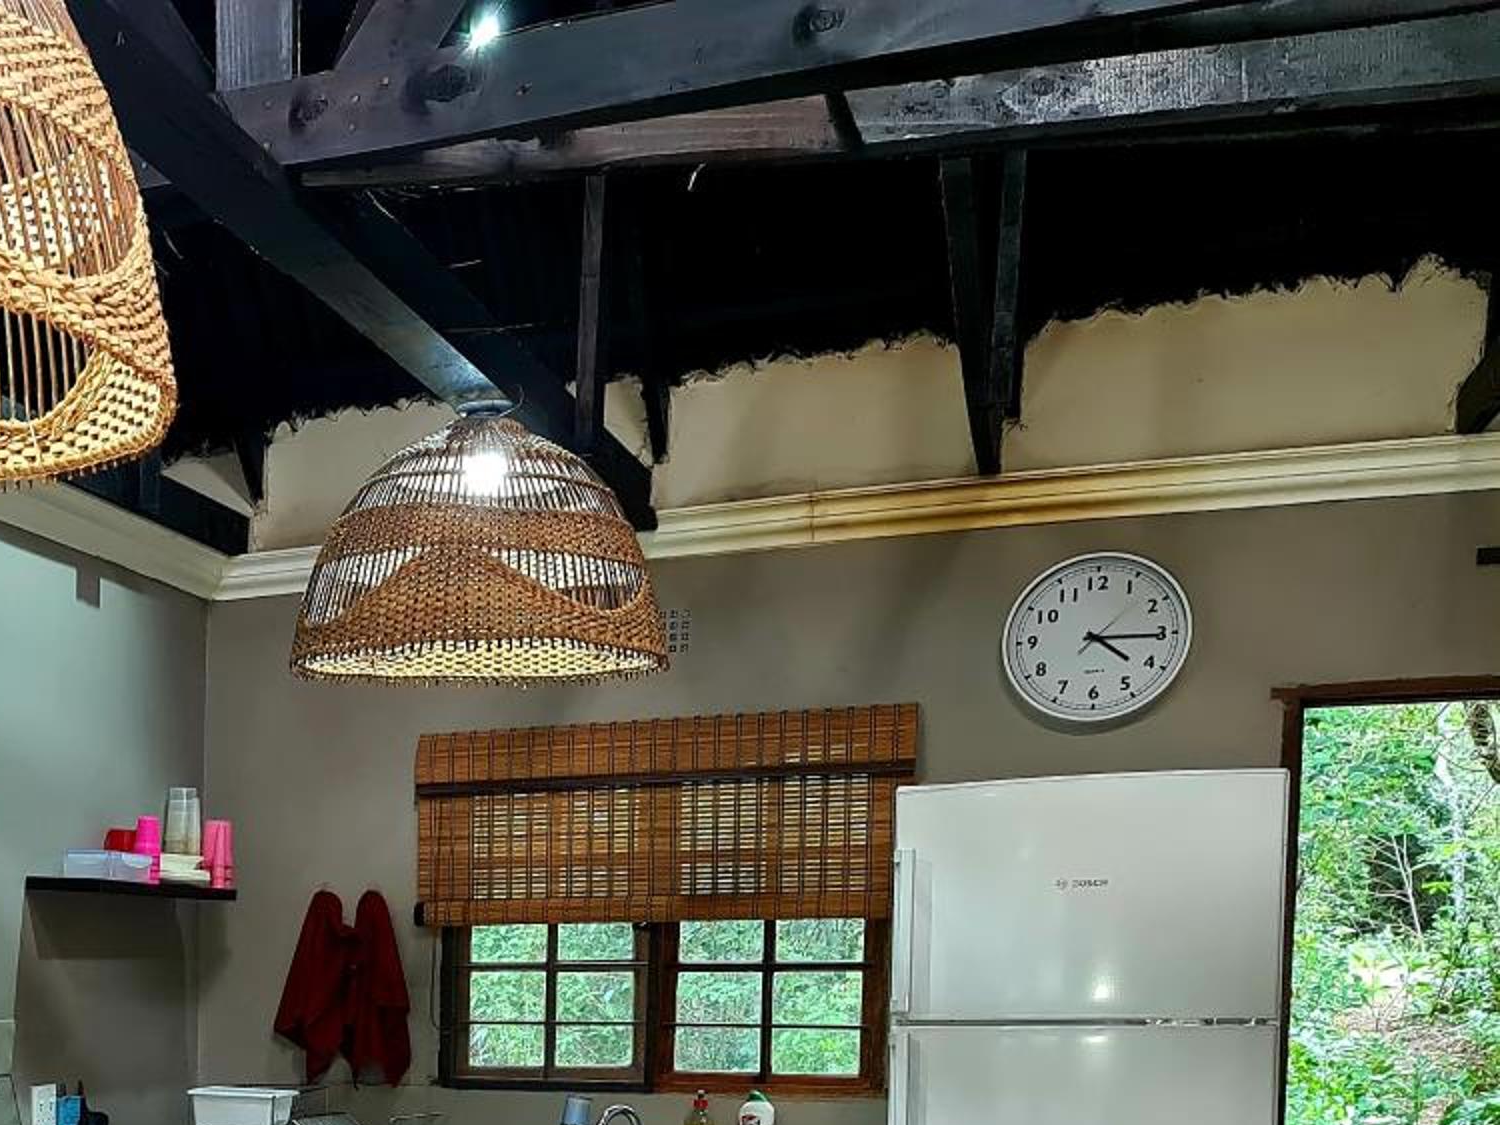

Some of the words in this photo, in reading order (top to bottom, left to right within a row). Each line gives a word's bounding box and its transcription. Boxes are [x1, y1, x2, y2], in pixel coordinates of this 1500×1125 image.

[1087, 575, 1109, 592] 12
[1127, 579, 1133, 595] 1
[1059, 587, 1078, 603] 11
[1147, 598, 1159, 614] 2
[1037, 609, 1059, 625] 10
[1156, 625, 1167, 641] 3
[1027, 635, 1038, 650] 9
[1035, 662, 1047, 677] 8
[1143, 655, 1155, 670] 4
[1057, 679, 1069, 694] 7
[1120, 675, 1131, 691] 5
[1088, 685, 1099, 700] 6
